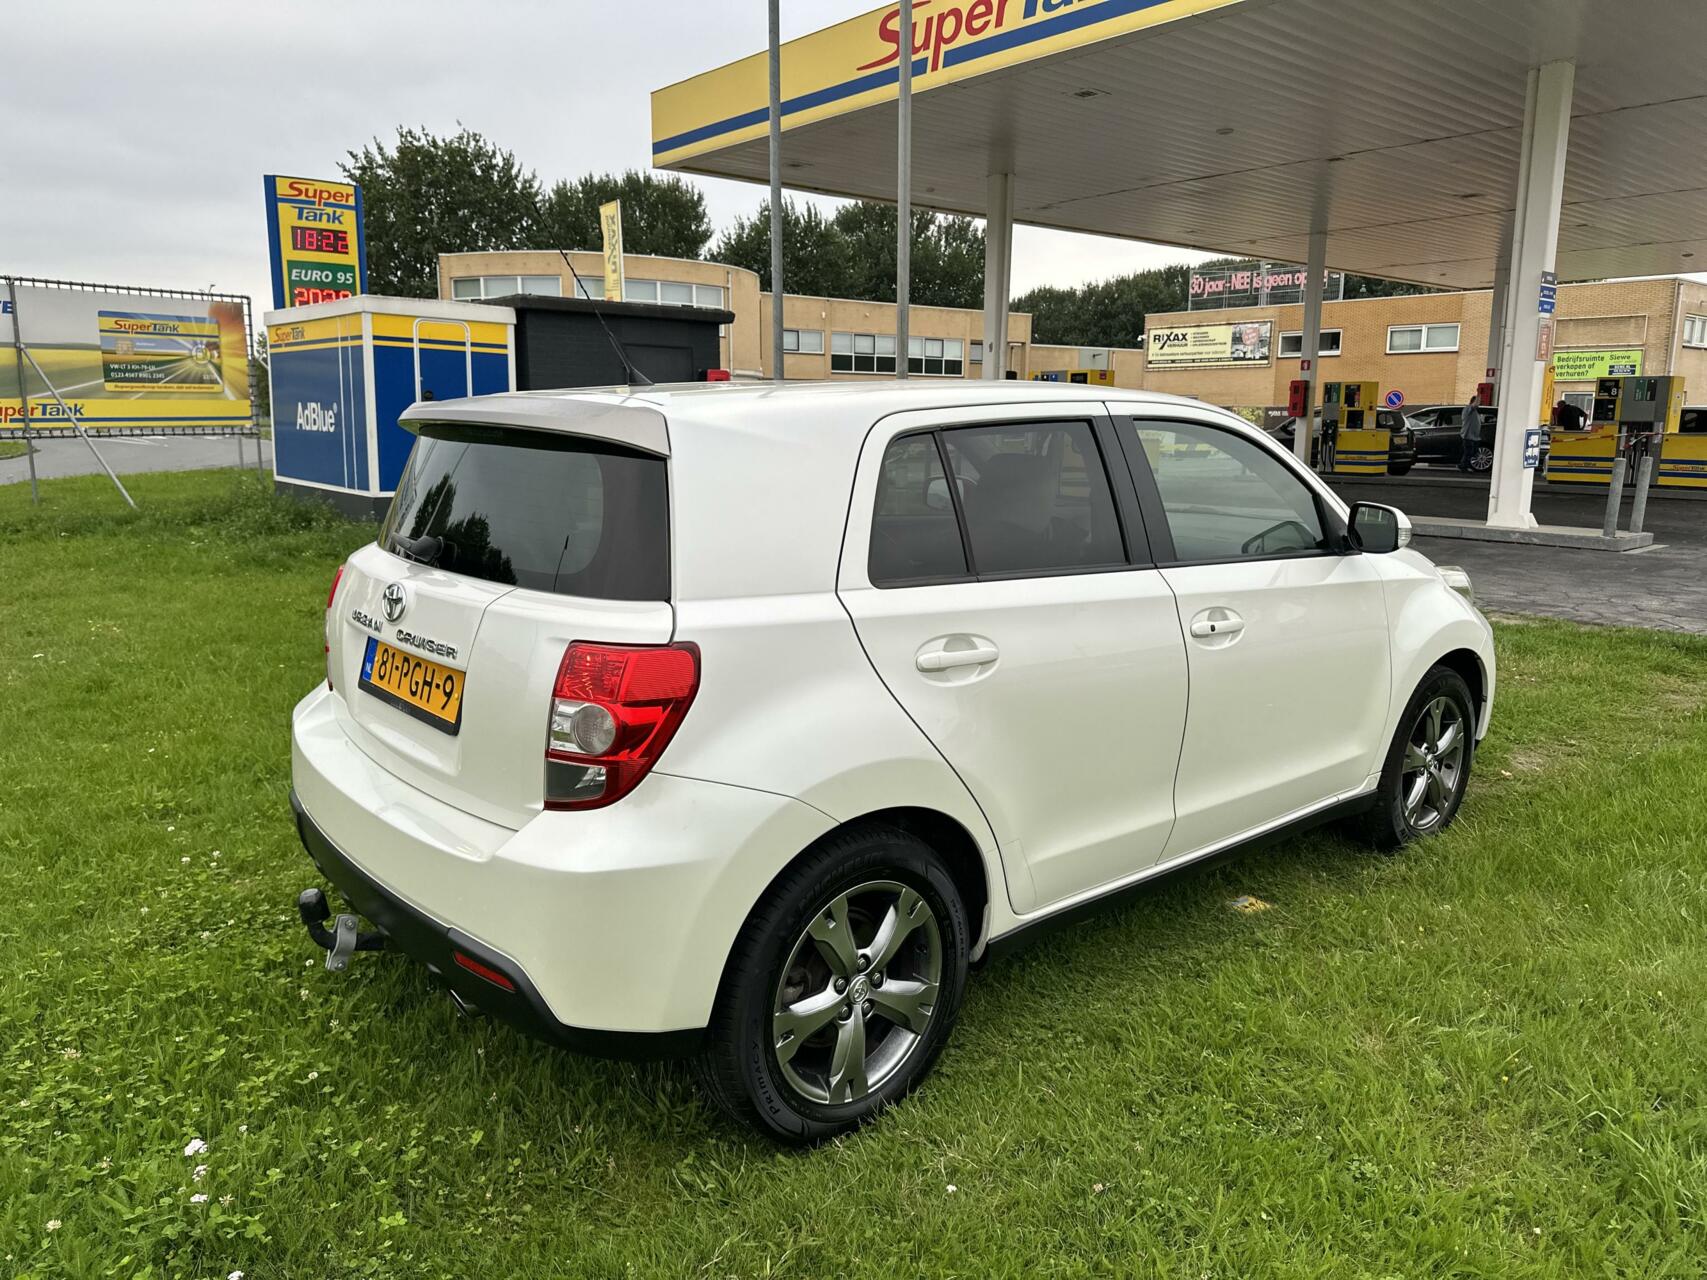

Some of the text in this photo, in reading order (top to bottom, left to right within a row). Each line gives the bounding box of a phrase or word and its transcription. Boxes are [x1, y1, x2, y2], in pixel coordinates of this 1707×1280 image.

[278, 181, 353, 207] Super
[291, 205, 344, 225] Tank
[296, 229, 348, 252] 18:22
[291, 269, 353, 284] EURO 95
[1190, 275, 1203, 294] 30
[1252, 273, 1262, 289] is
[1264, 273, 1292, 291] geen
[109, 320, 179, 335] SuperTank
[1557, 354, 1605, 364] Bedrijfsruimte
[352, 608, 384, 633] URBAN
[396, 629, 458, 660] CRUISER
[378, 647, 455, 711] 81-PGH-9
